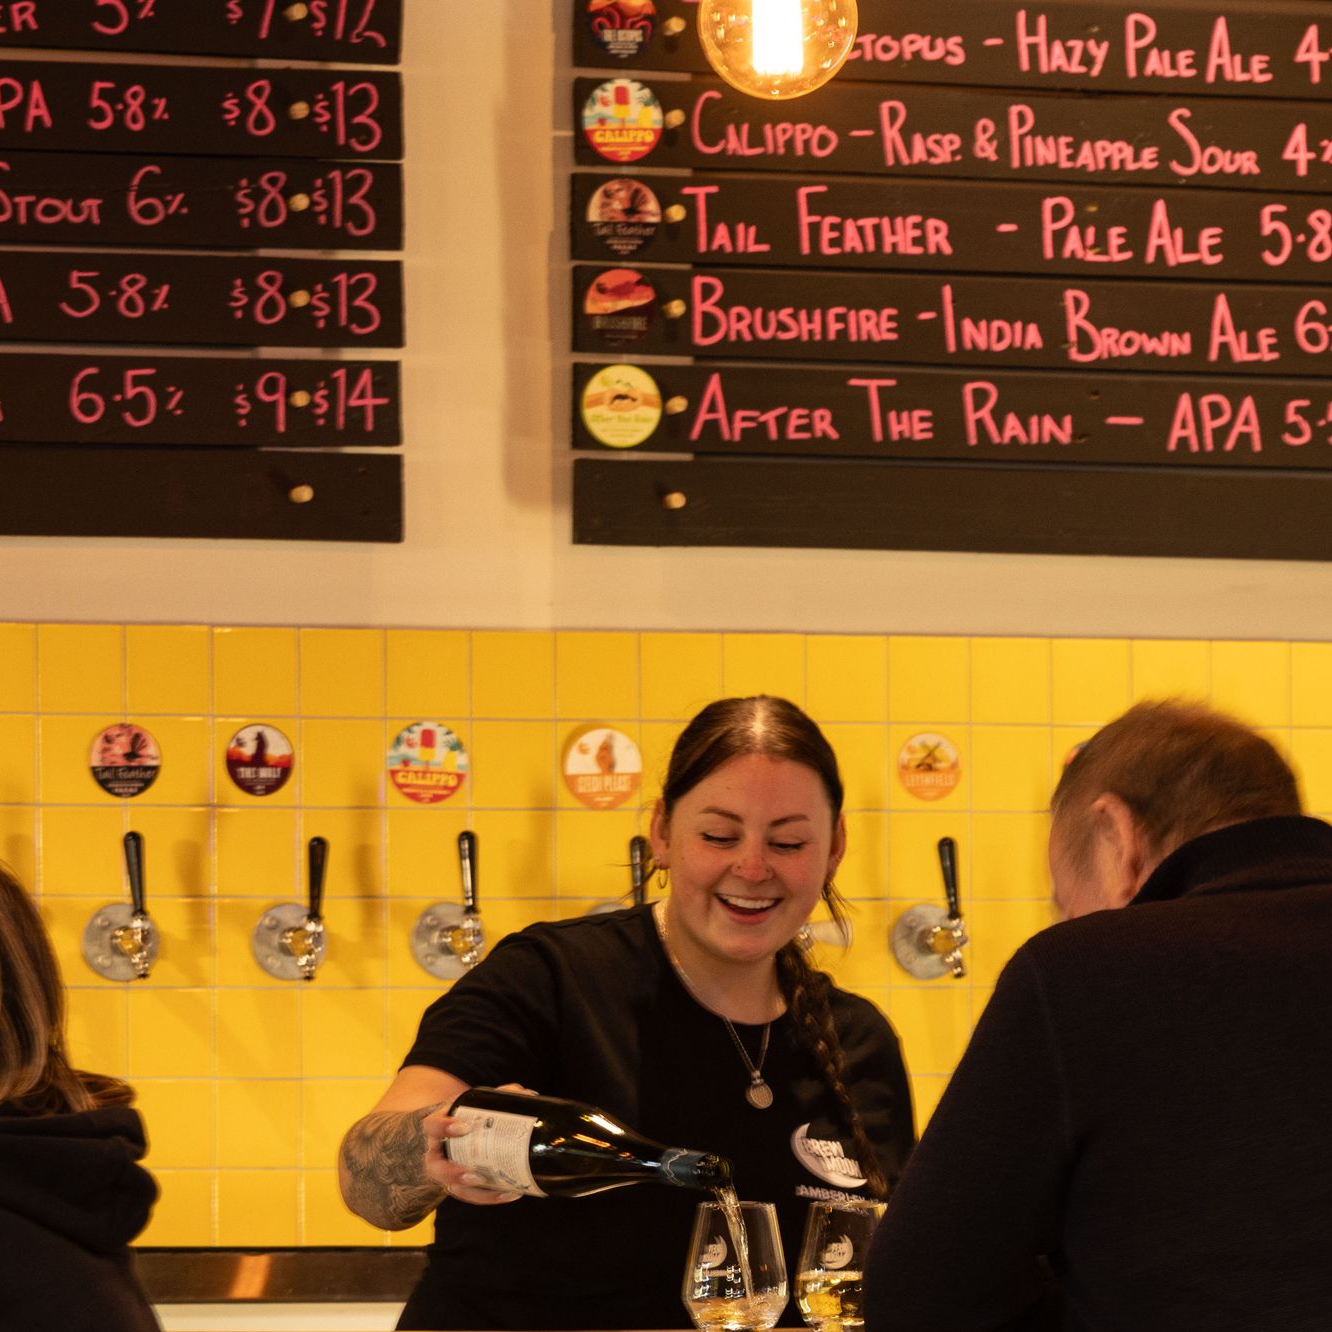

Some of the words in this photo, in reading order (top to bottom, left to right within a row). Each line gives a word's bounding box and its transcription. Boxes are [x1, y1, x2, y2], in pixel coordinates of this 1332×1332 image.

[848, 31, 967, 68] TOPUS
[221, 79, 276, 137] $8
[313, 81, 382, 152] $13
[972, 116, 1000, 163] &
[236, 171, 287, 228] $8
[312, 168, 376, 236] $13
[229, 270, 286, 325] $8
[309, 272, 381, 335] $13
[234, 371, 286, 433] $9
[312, 367, 390, 432] $14
[1166, 391, 1263, 454] APA
